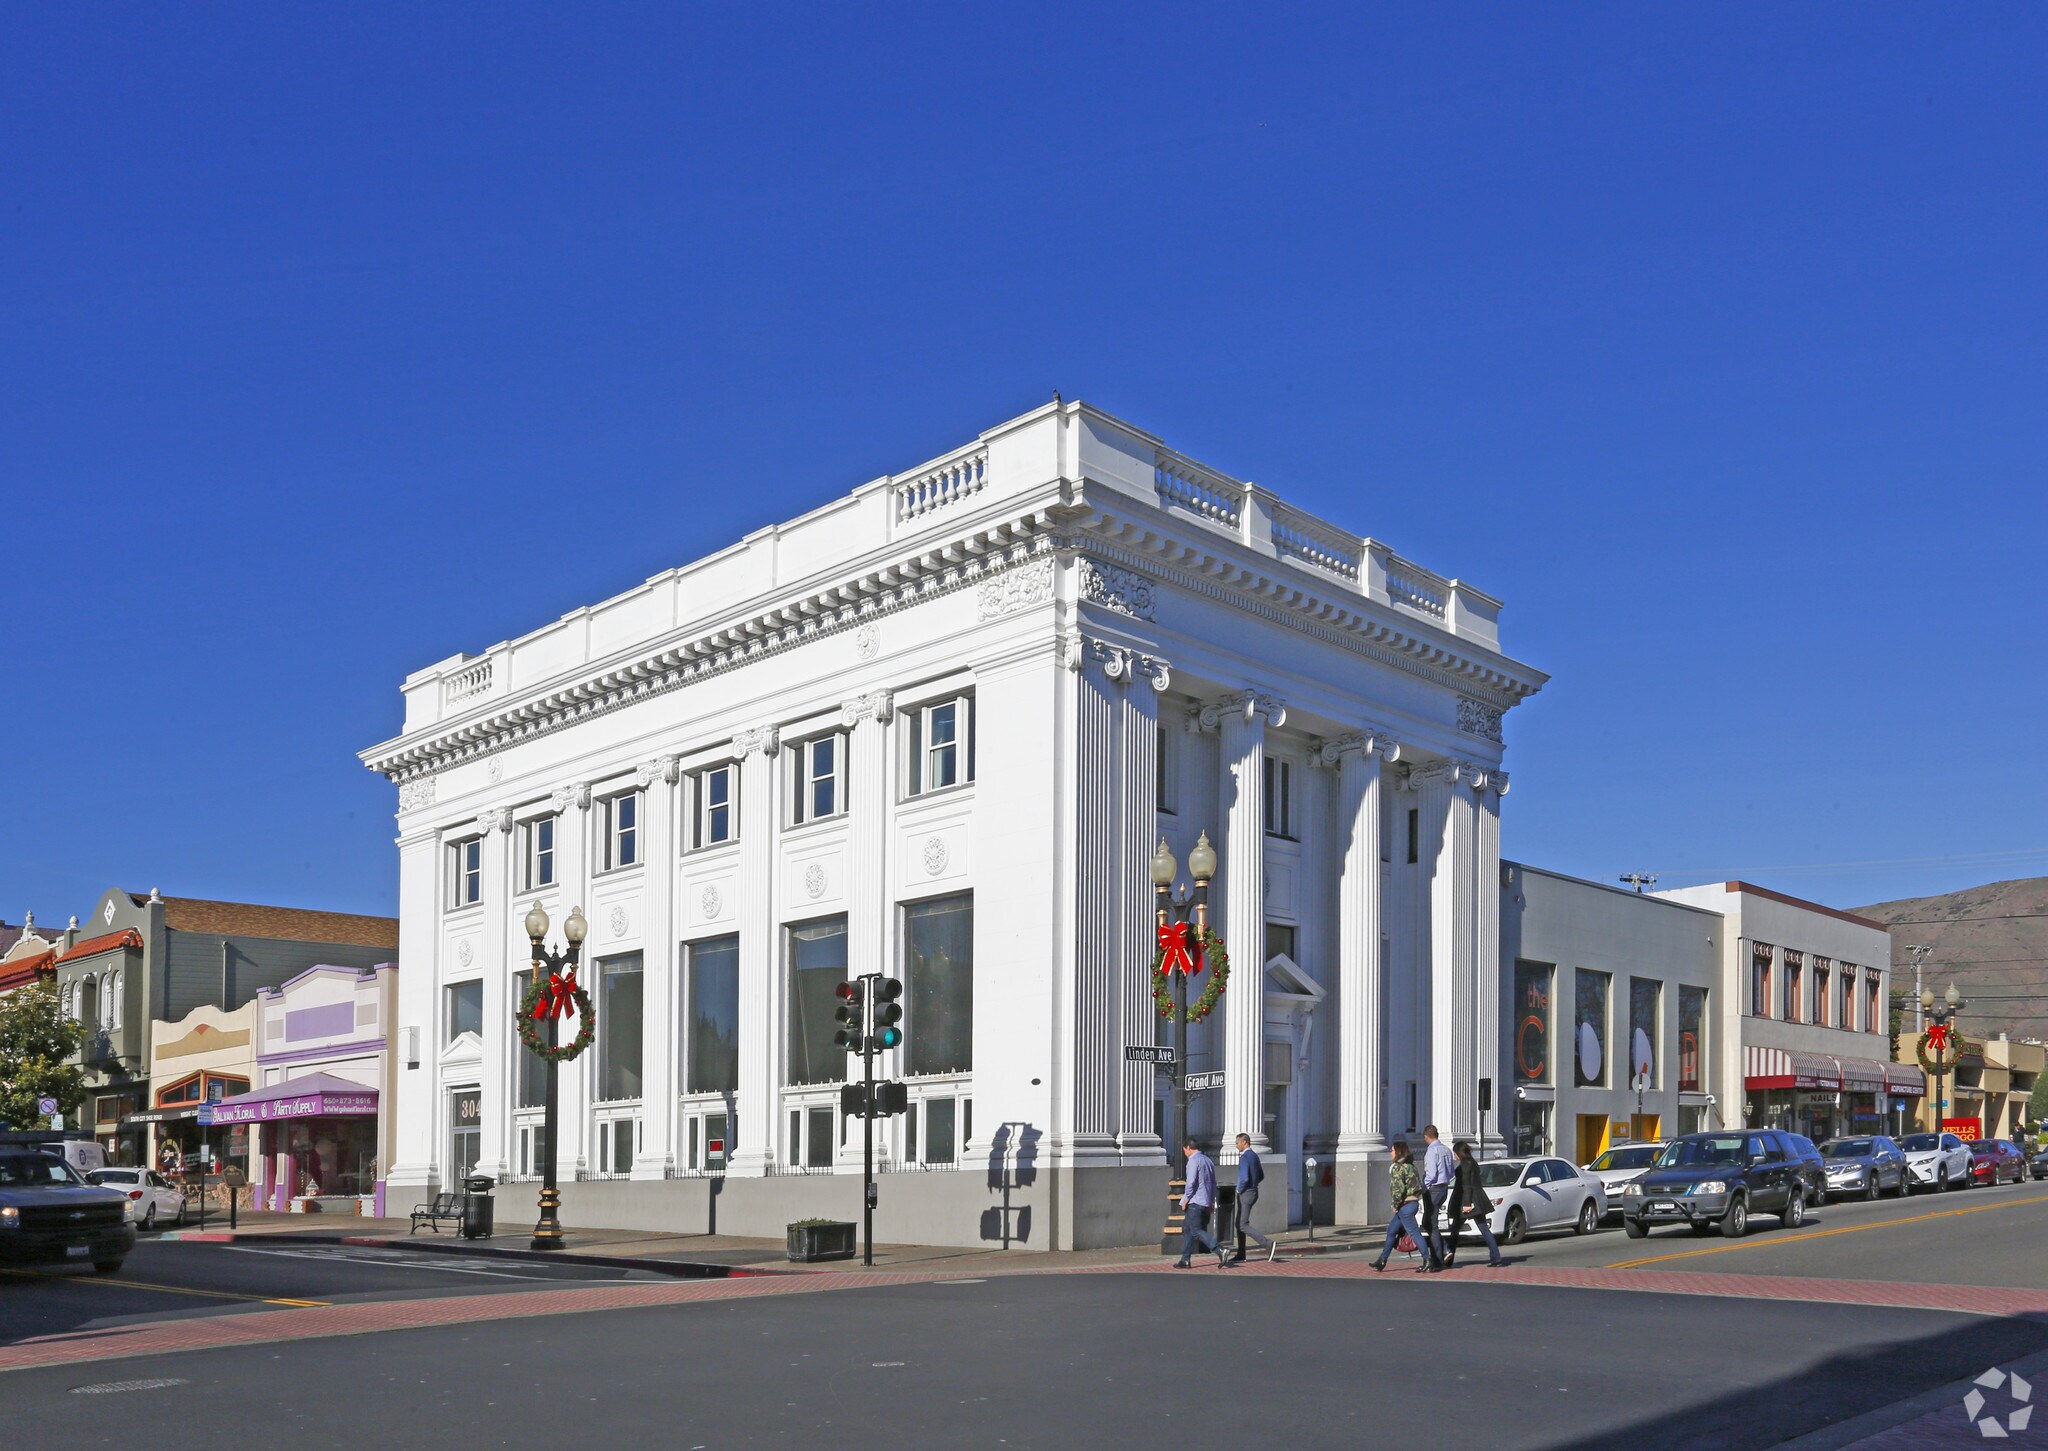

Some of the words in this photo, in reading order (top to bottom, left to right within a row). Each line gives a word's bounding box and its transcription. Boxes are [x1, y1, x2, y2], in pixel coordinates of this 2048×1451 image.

[1527, 979, 1549, 1009] the
[1128, 1047, 1155, 1061] Linden
[1158, 1049, 1172, 1061] Ave
[1187, 1074, 1209, 1089] Grand
[1211, 1074, 1224, 1087] Ave
[1810, 1093, 1837, 1102] NAILS
[1941, 1126, 1976, 1134] WELLS
